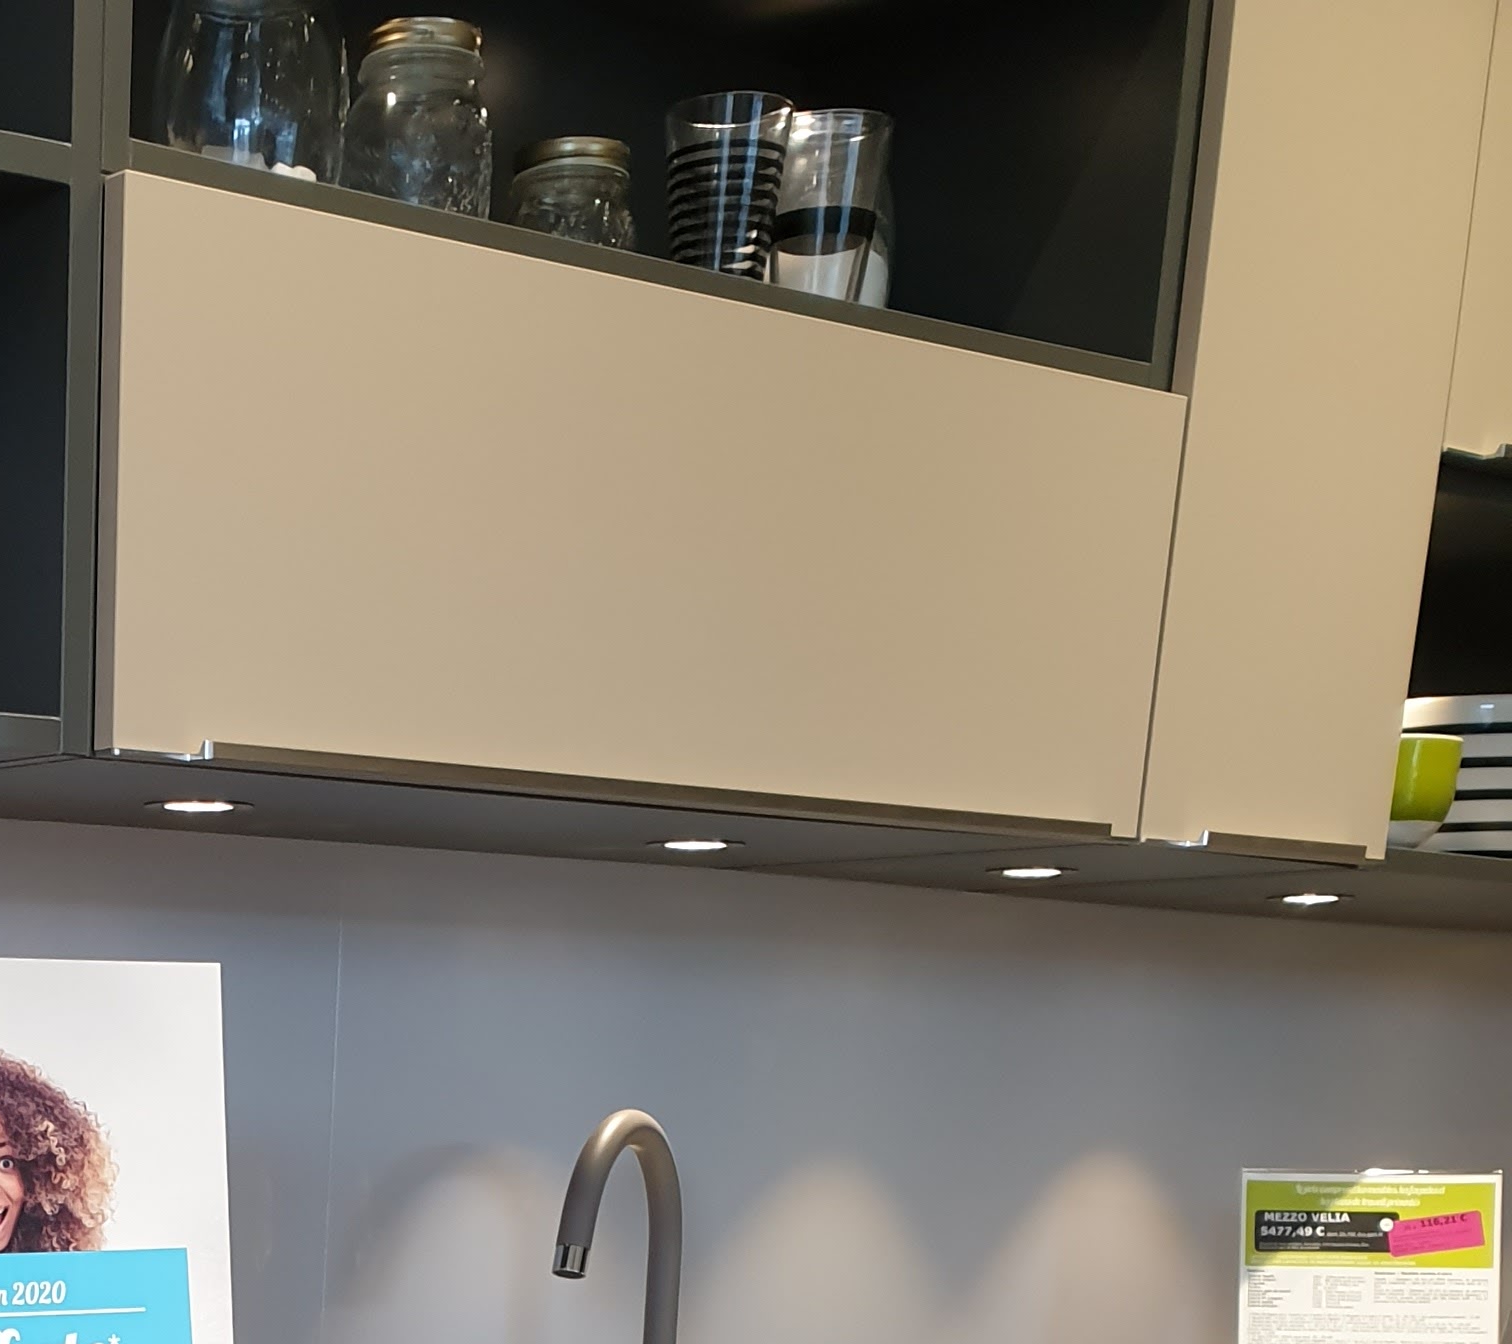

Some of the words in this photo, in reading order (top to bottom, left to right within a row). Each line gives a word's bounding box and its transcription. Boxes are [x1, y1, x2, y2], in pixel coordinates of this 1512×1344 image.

[1263, 1211, 1308, 1223] MEZZO
[1310, 1211, 1351, 1223] VELIA
[11, 1280, 68, 1307] 2020
